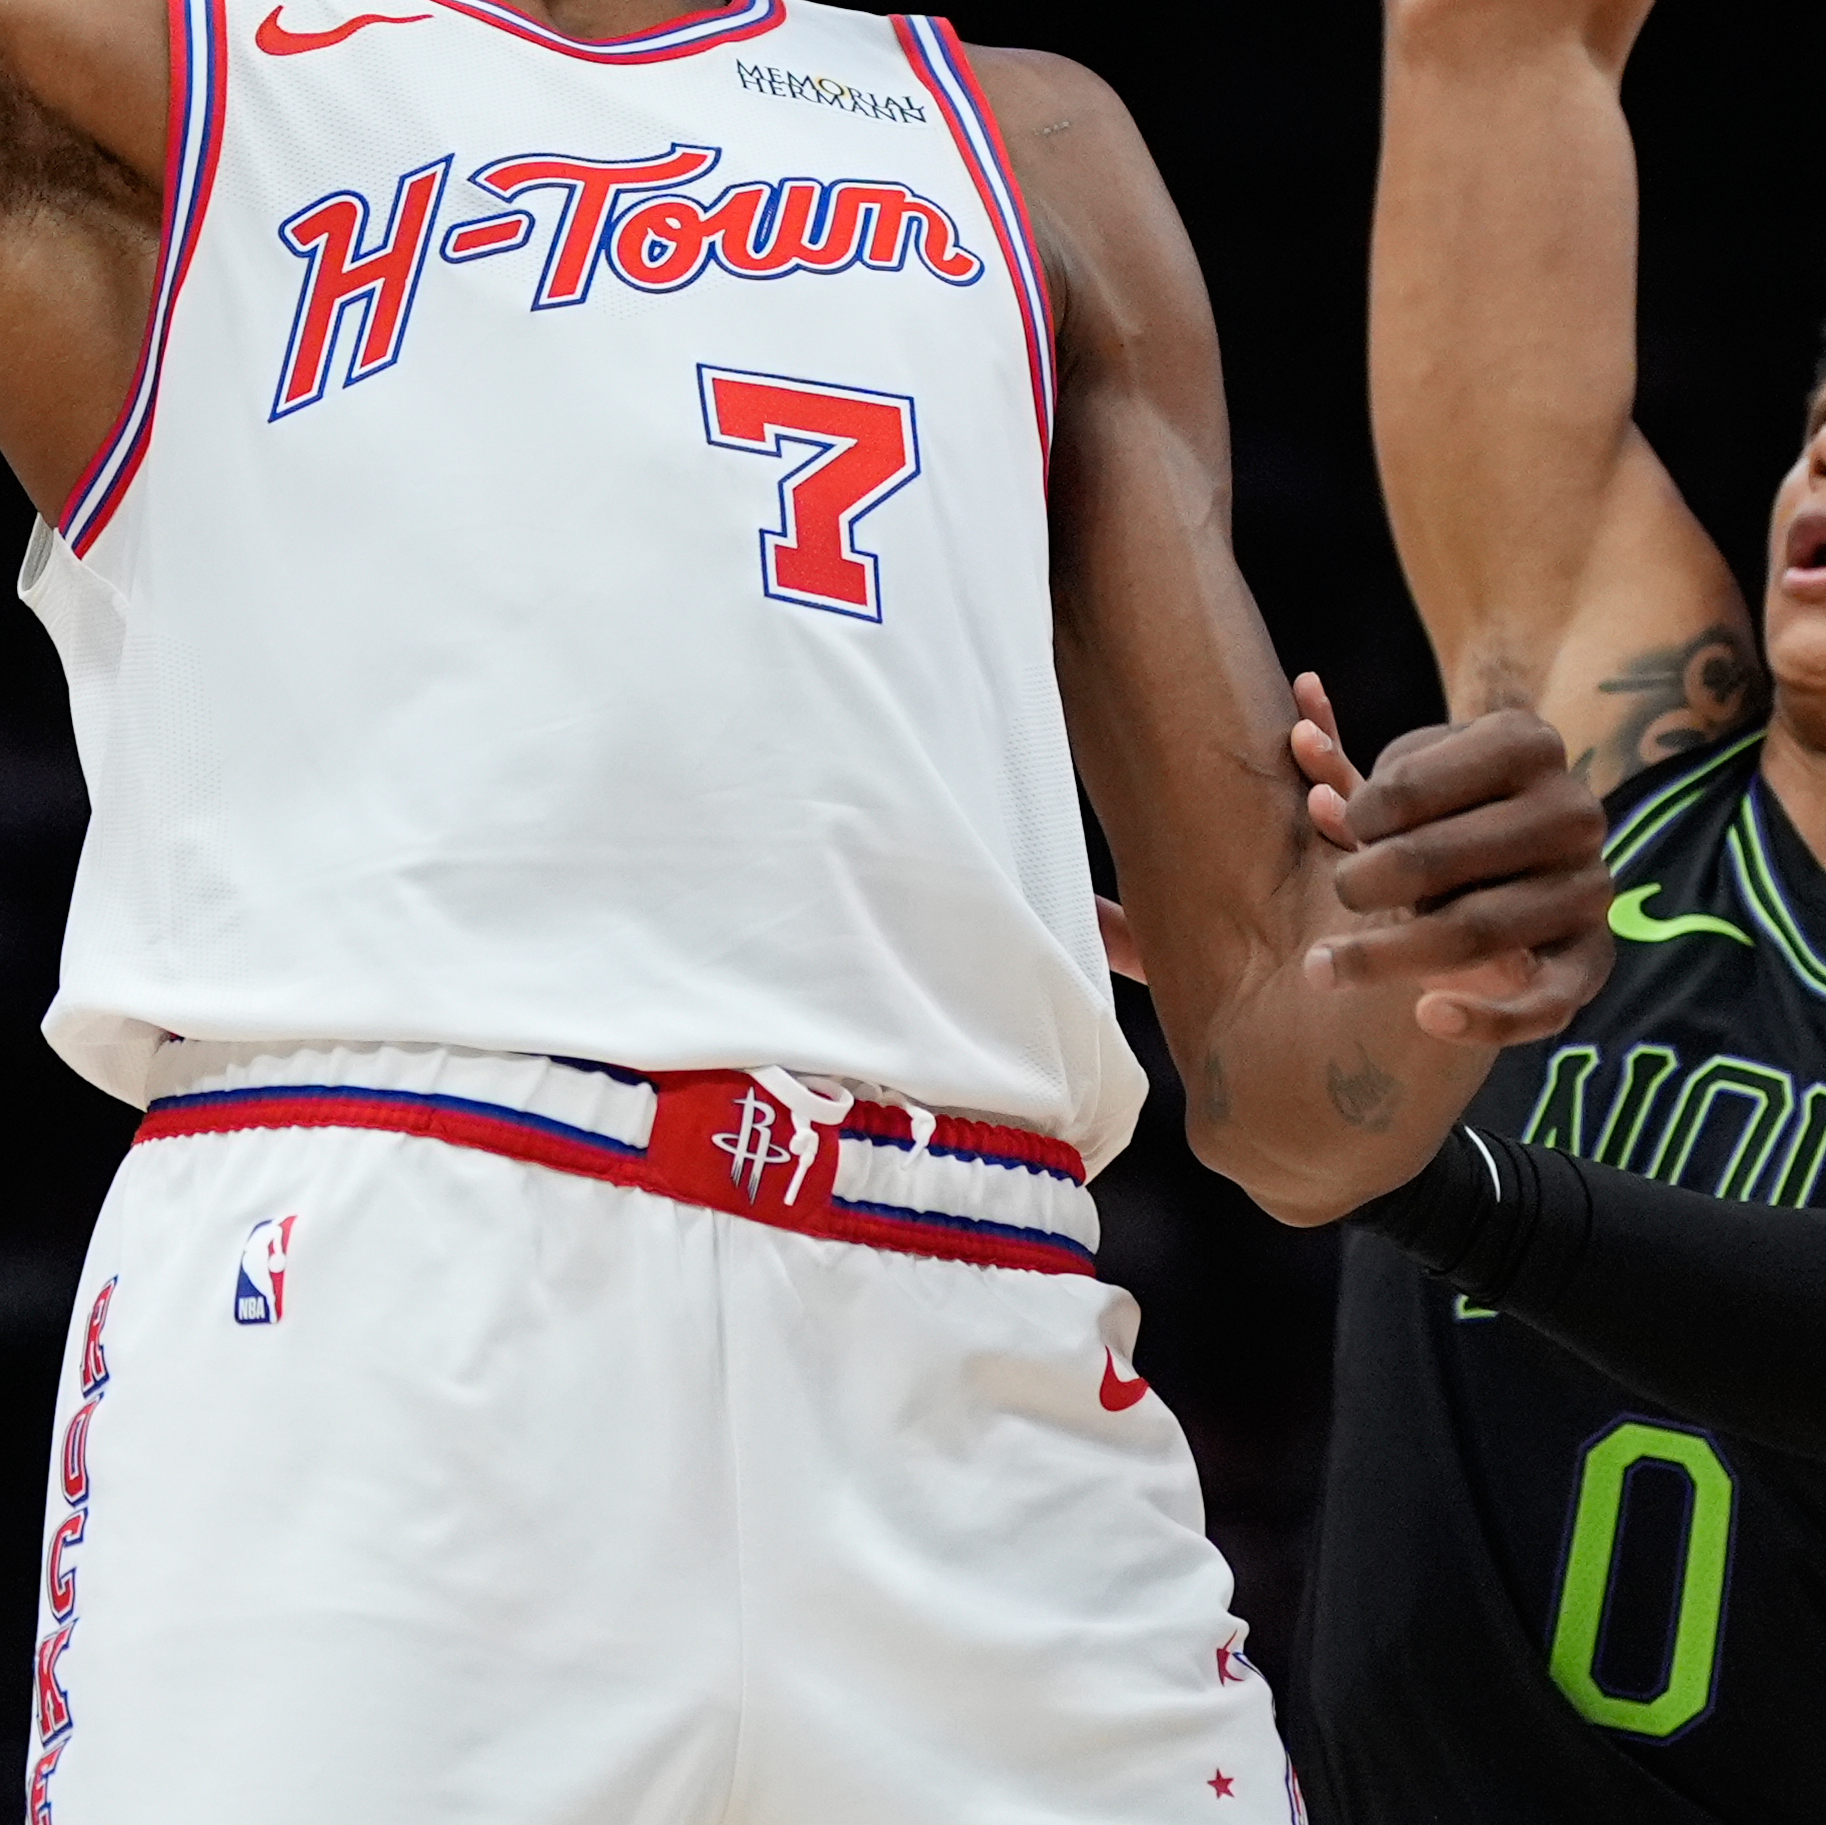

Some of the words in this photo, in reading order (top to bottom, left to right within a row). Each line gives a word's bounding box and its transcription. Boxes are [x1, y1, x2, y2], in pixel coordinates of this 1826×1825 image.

[736, 58, 925, 111] MEMORIAL
[737, 73, 927, 124] HERMANN
[268, 142, 986, 423] H-Town
[696, 363, 921, 624] 7
[238, 1296, 266, 1321] NBA
[1548, 1415, 1736, 1743] 0
